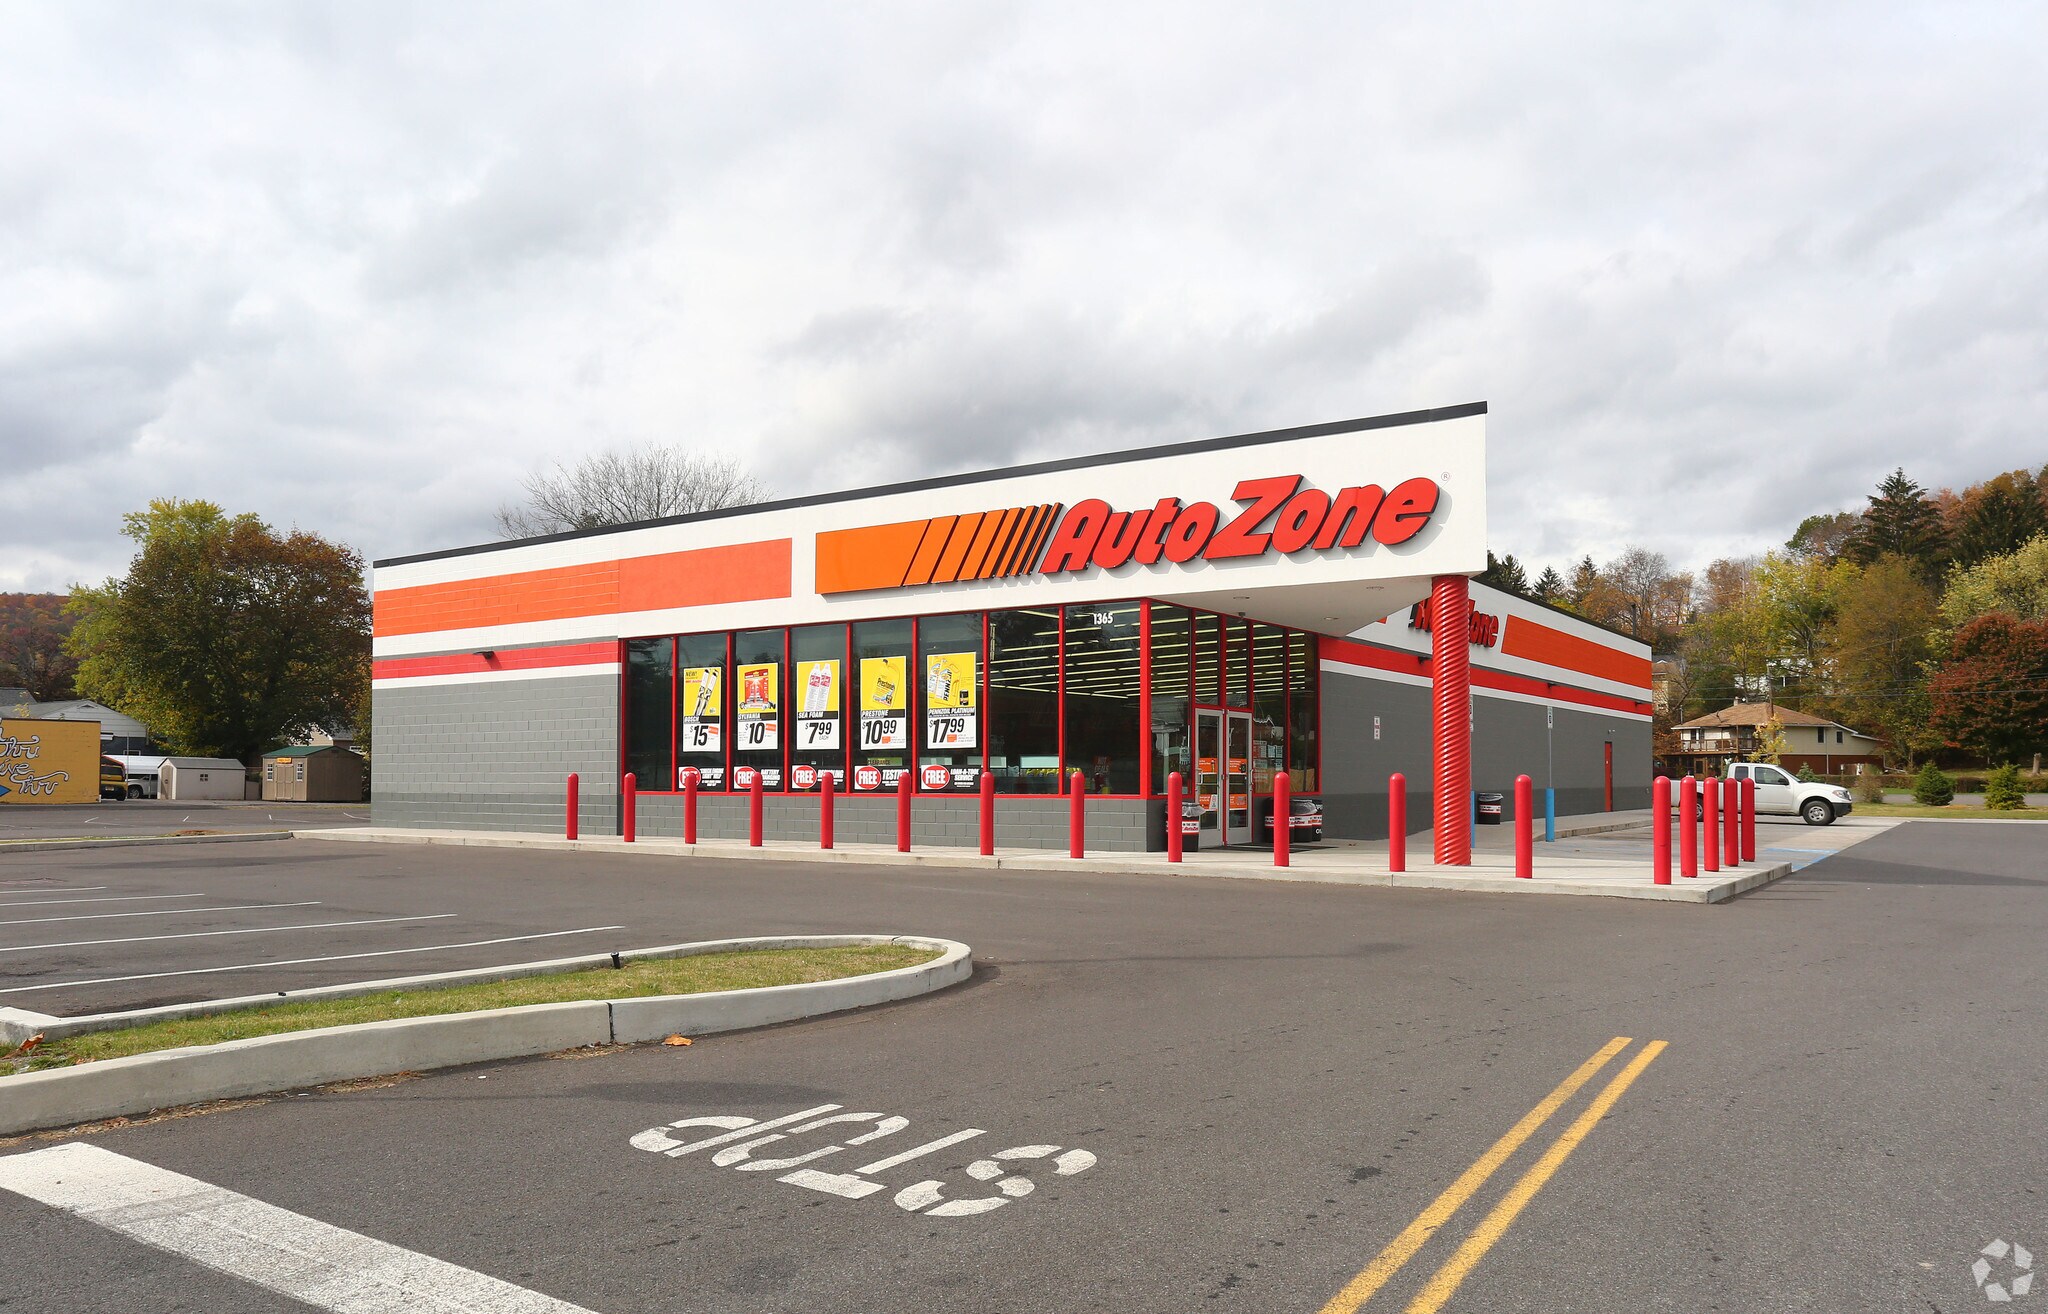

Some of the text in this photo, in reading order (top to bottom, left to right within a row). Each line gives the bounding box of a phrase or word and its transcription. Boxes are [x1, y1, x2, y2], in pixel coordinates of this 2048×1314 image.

[1038, 474, 1441, 574] AutoZone
[1093, 612, 1114, 625] 1365
[795, 769, 814, 784] FREE
[858, 770, 878, 785] FREE
[925, 769, 946, 784] FREE
[629, 1103, 1098, 1217] STOP
